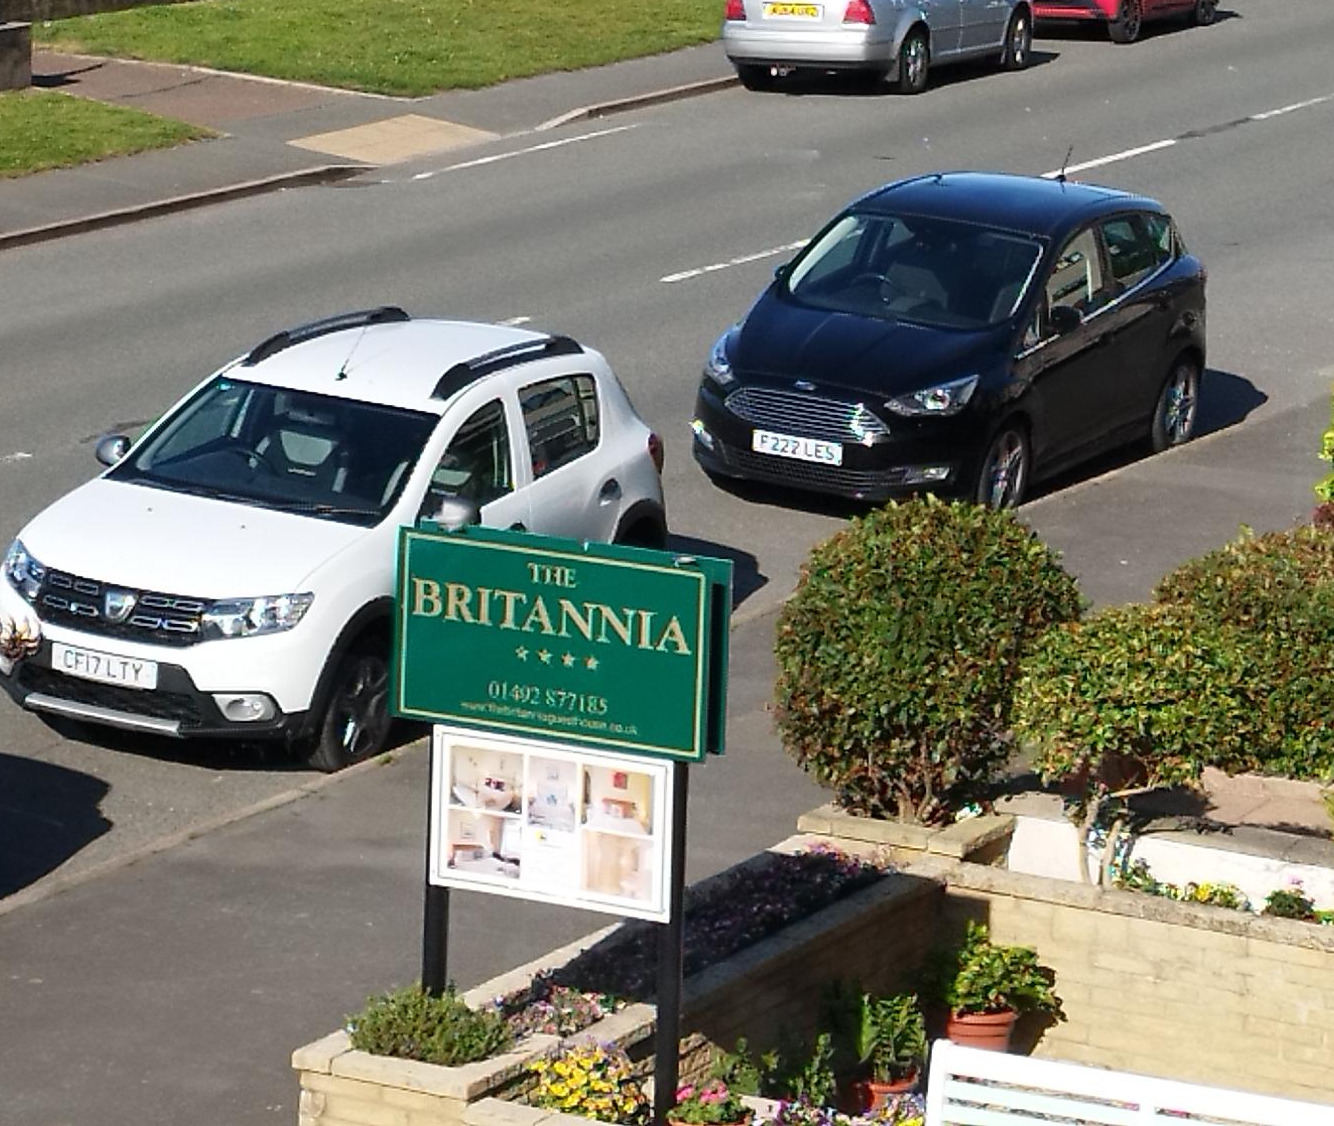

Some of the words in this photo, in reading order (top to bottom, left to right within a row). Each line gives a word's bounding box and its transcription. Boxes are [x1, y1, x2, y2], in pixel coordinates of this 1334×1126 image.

[804, 442, 835, 461] LES
[527, 562, 578, 589] THE
[412, 578, 692, 656] BRITANNIA
[107, 658, 144, 682] LTY
[488, 680, 540, 706] 01492
[545, 689, 609, 715] 877185
